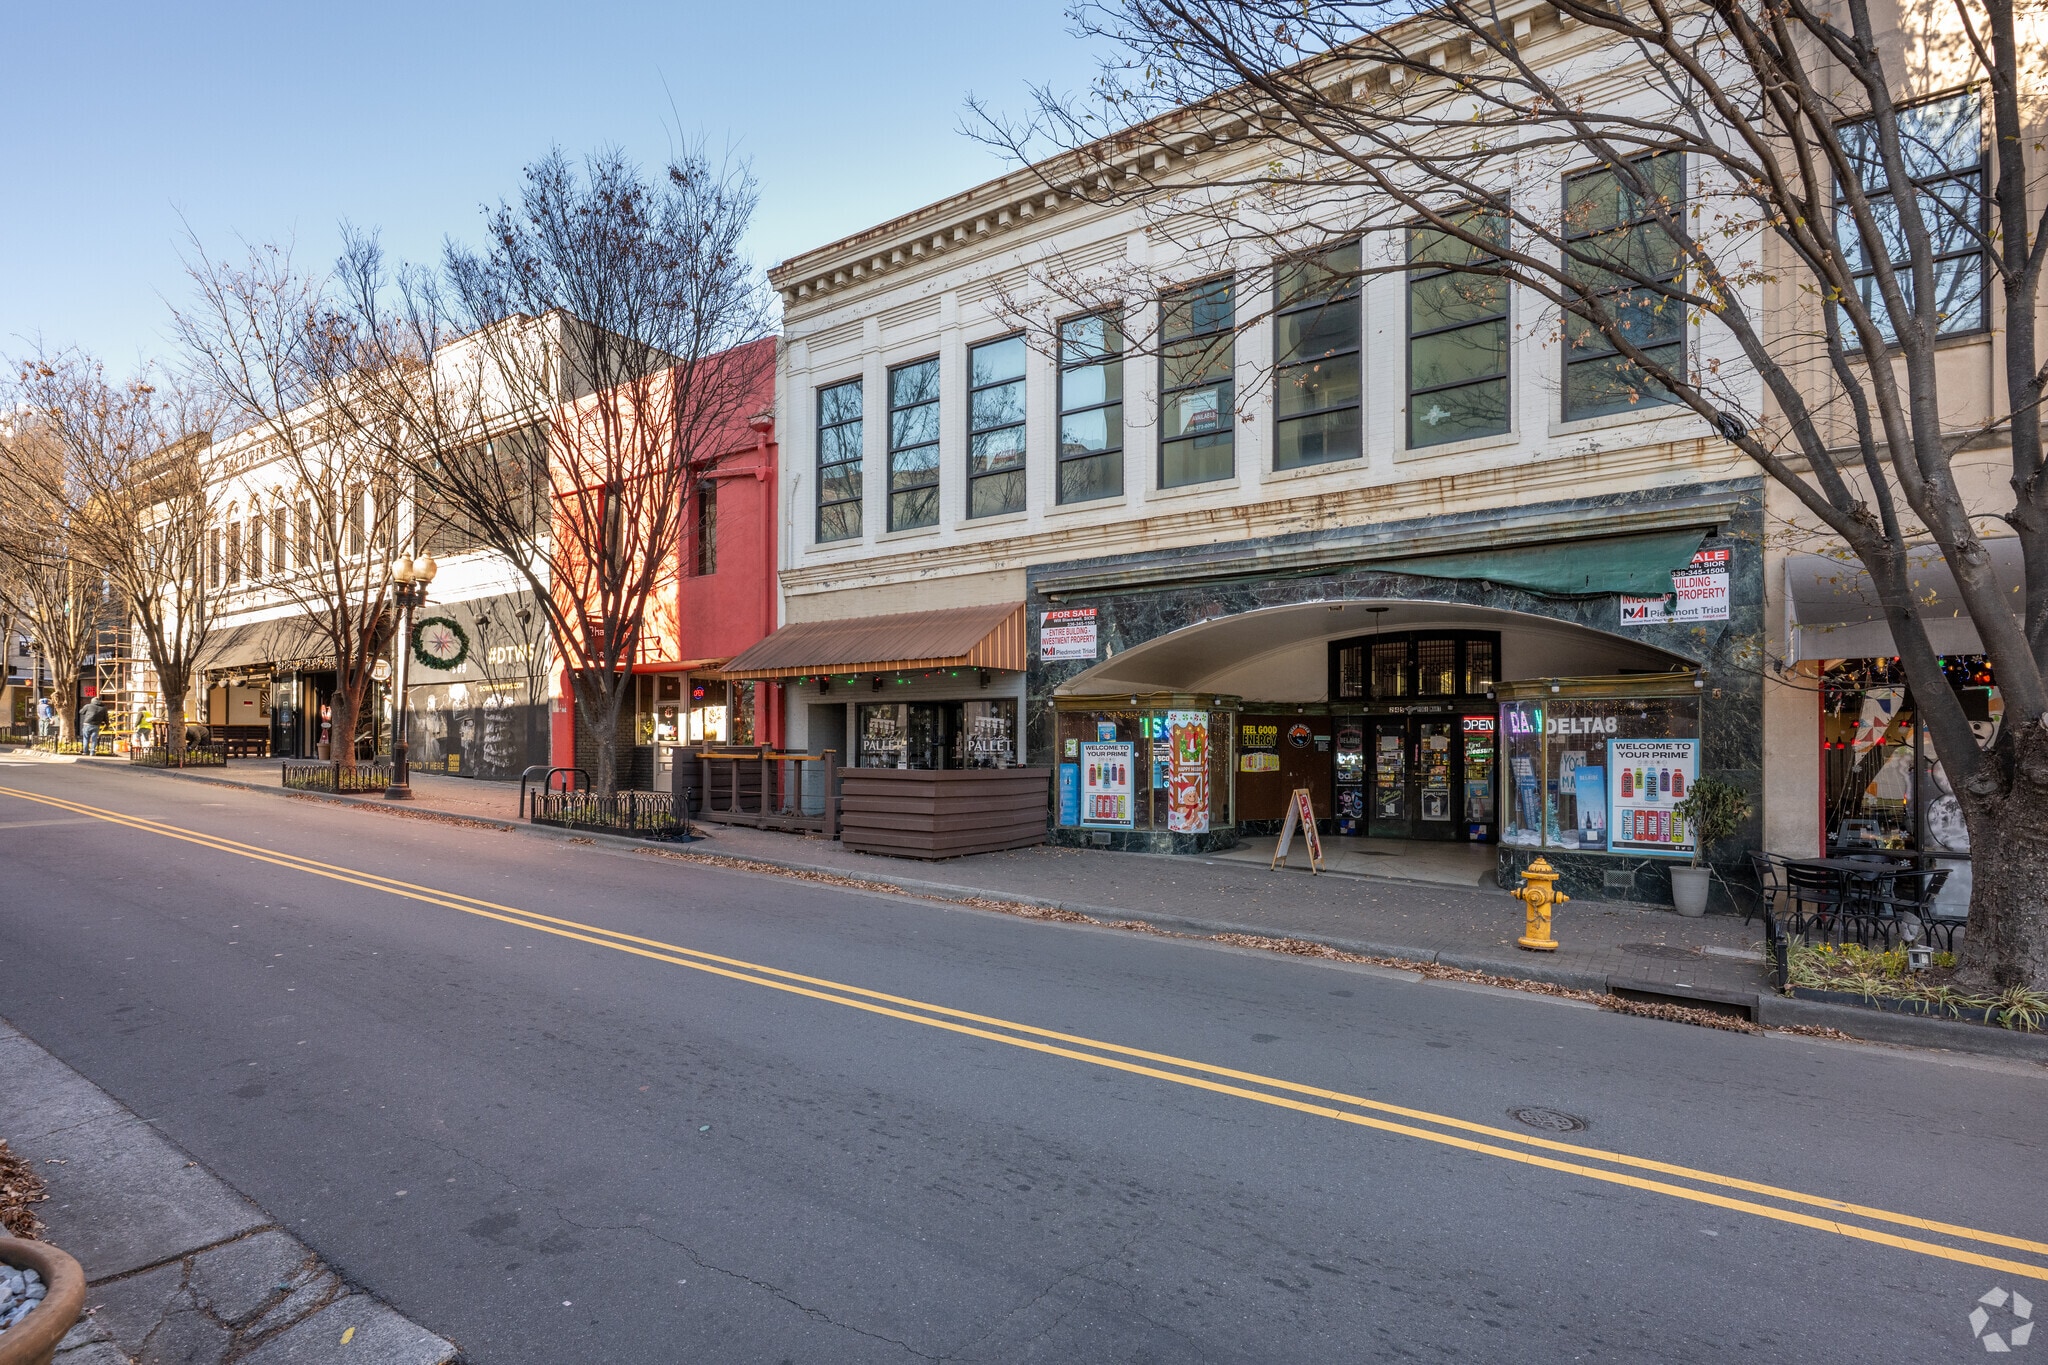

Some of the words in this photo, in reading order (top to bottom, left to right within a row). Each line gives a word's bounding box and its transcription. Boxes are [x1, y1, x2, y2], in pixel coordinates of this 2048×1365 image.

[1691, 550, 1726, 563] ALE
[1672, 576, 1711, 589] UILDING
[1622, 593, 1672, 604] INVESTMEN
[1678, 587, 1726, 600] PROPERTY
[1623, 605, 1648, 619] NAI
[1650, 607, 1699, 618] Piemont
[1701, 605, 1727, 615] Triad
[1049, 628, 1065, 636] ENTIRE
[1066, 627, 1088, 636] BUILDING
[1041, 636, 1070, 645] INVESTMENT
[1071, 635, 1095, 643] PROPERTY
[1243, 725, 1257, 734] FEEL
[1258, 725, 1278, 734] GOOD
[1463, 720, 1494, 731] OPEN
[1546, 716, 1617, 734] DELTA8
[863, 740, 901, 751] PALLET
[968, 740, 1012, 751] PALLET
[1243, 734, 1278, 746] ENERGY
[1618, 751, 1650, 759] YOUR
[1652, 751, 1689, 759] PRIME
[409, 761, 423, 770] FIND
[430, 761, 445, 771] HERE
[1647, 776, 1657, 797] PRIME
